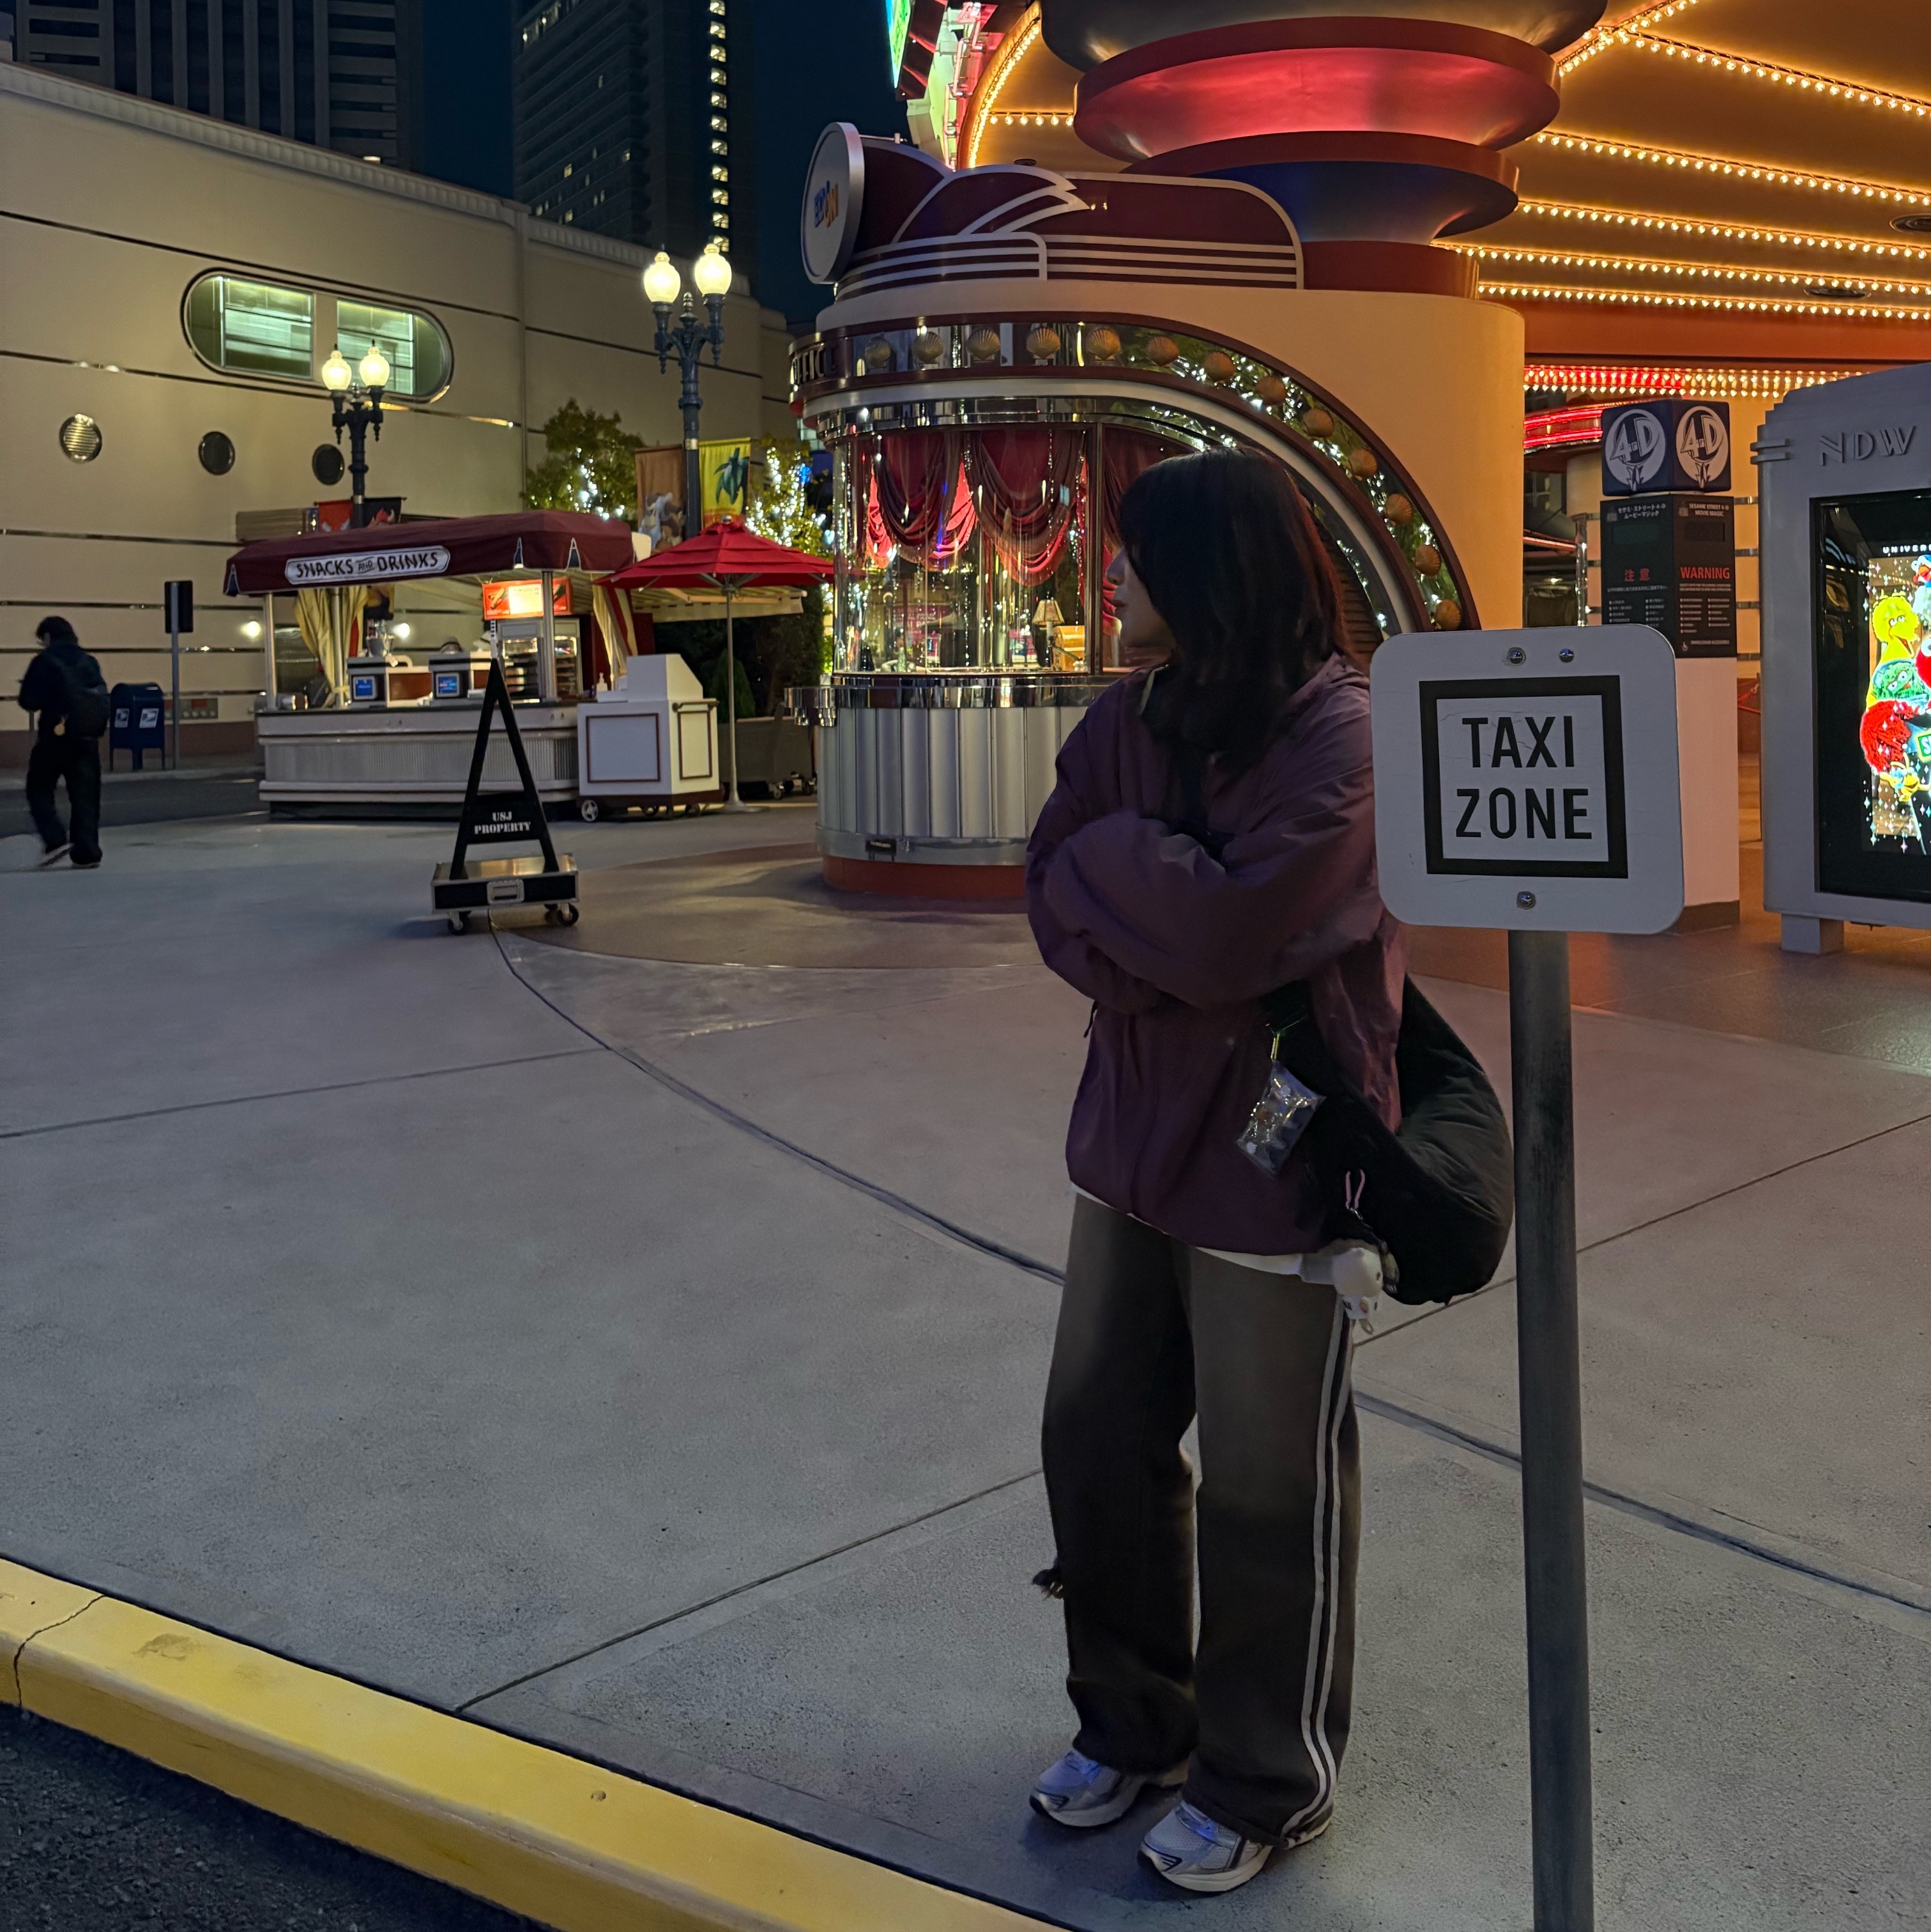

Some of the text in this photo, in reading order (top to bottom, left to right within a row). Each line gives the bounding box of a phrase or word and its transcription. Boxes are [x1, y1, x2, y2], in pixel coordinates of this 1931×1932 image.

[1820, 425, 1916, 466] NDW
[296, 552, 438, 578] SNACKS AND DRINKS
[1680, 567, 1730, 579] WARNING
[1462, 716, 1575, 768] TAXI
[492, 811, 512, 822] USJ
[1456, 787, 1592, 839] ZONE
[474, 821, 531, 835] PROPERTY
